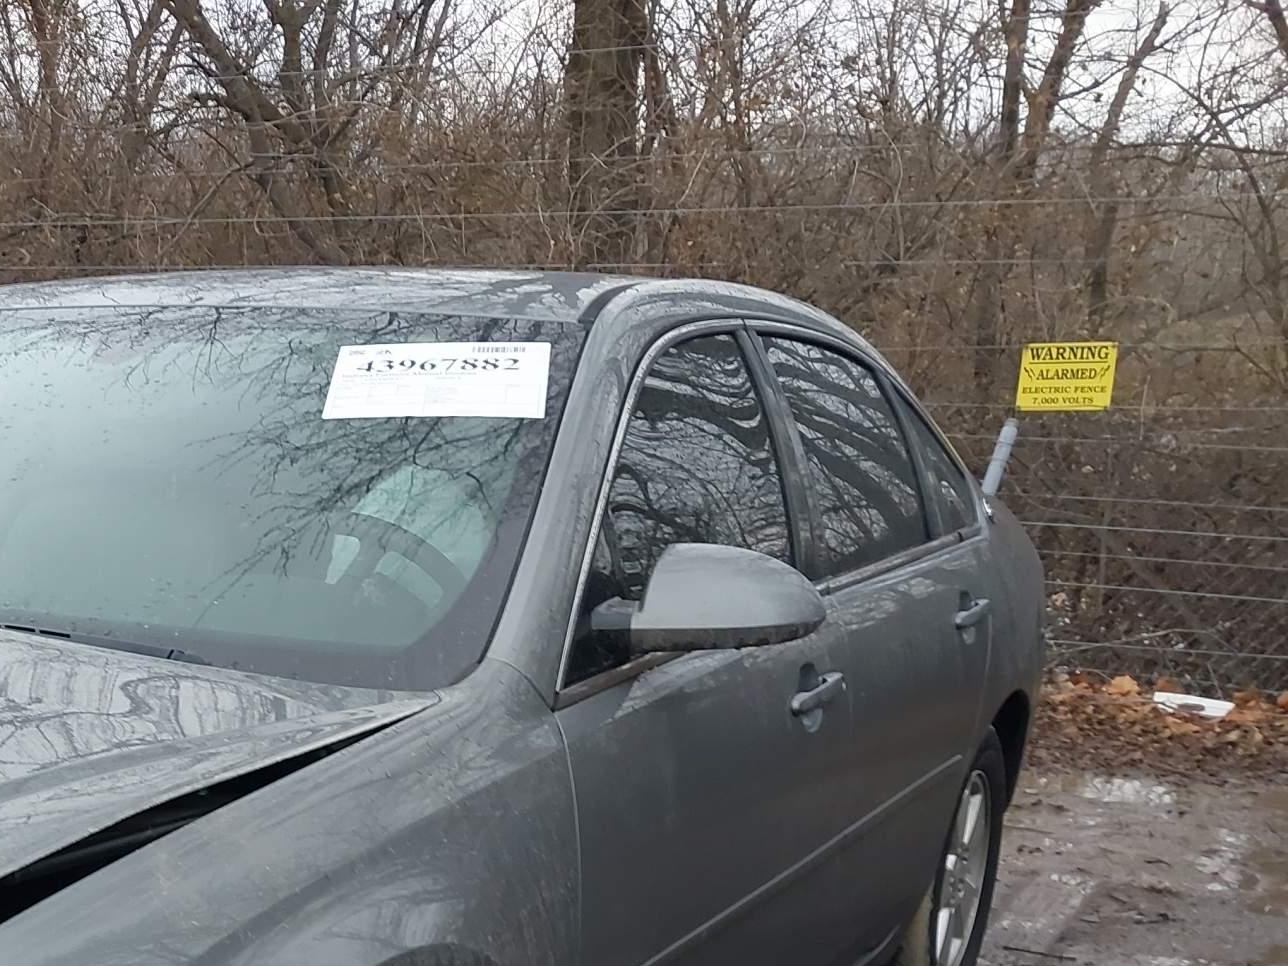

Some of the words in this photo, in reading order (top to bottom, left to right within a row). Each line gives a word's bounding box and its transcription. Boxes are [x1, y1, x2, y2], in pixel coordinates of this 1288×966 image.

[1030, 345, 1110, 361] WARNING
[356, 357, 520, 373] 43967882
[1036, 368, 1097, 380] ALARMED
[1022, 386, 1071, 394] ELECTRIC
[1073, 385, 1107, 393] FENCE
[1062, 396, 1094, 404] VOLTS
